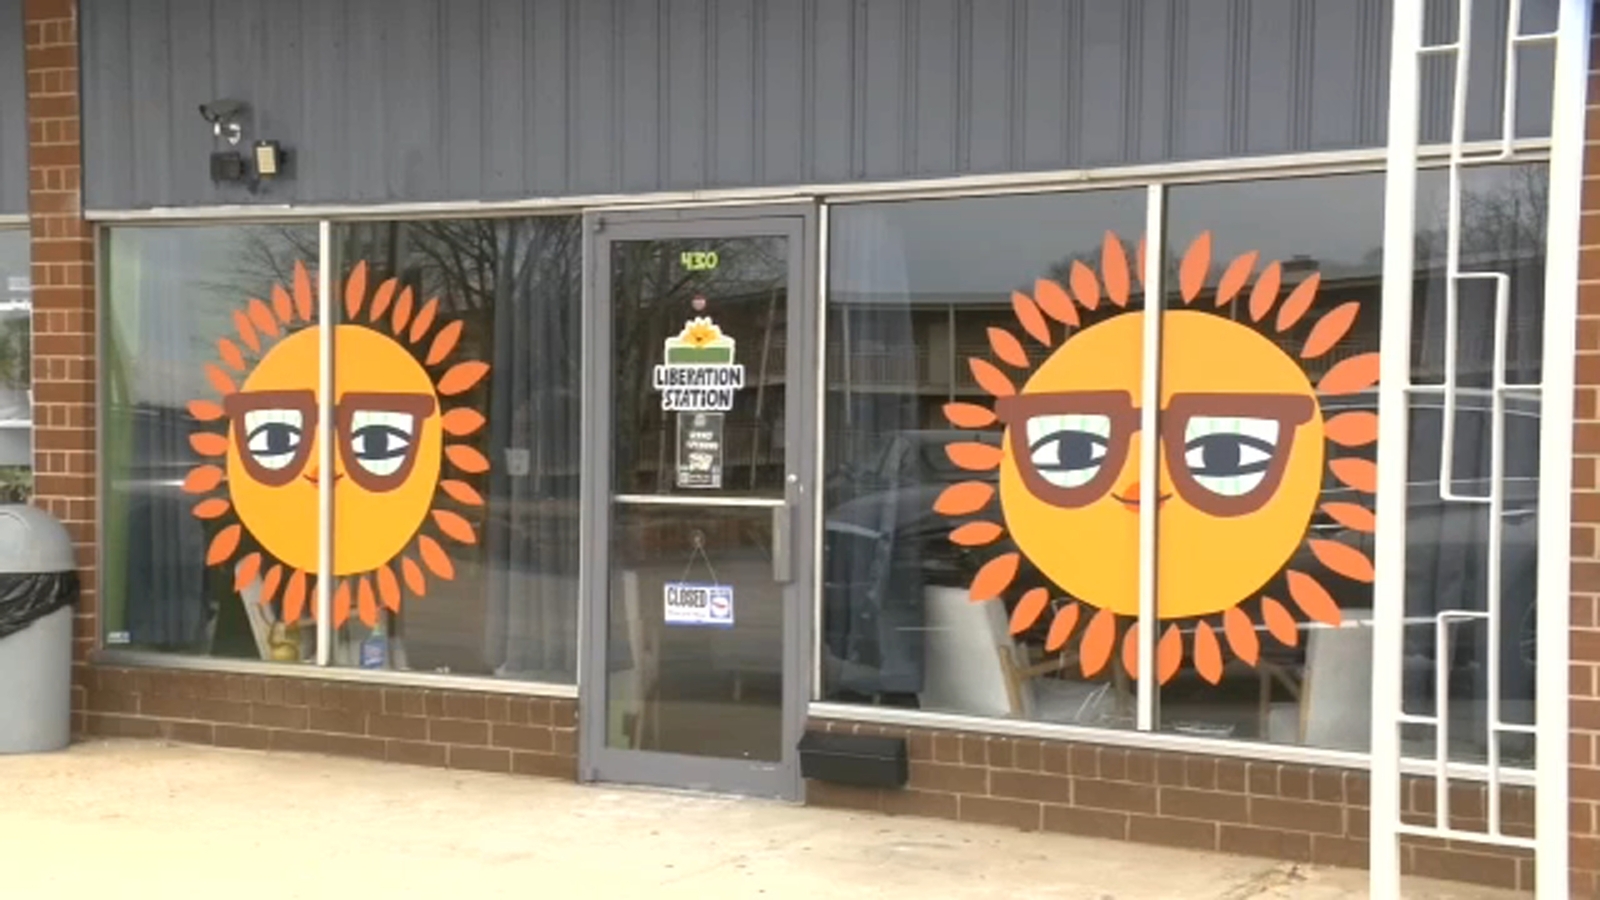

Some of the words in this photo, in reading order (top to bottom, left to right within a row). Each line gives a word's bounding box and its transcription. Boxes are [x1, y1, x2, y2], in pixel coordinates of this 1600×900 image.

[681, 251, 718, 270] 430
[656, 367, 742, 386] LIBERATION
[664, 389, 730, 407] STATION
[667, 587, 707, 608] CLOSED
